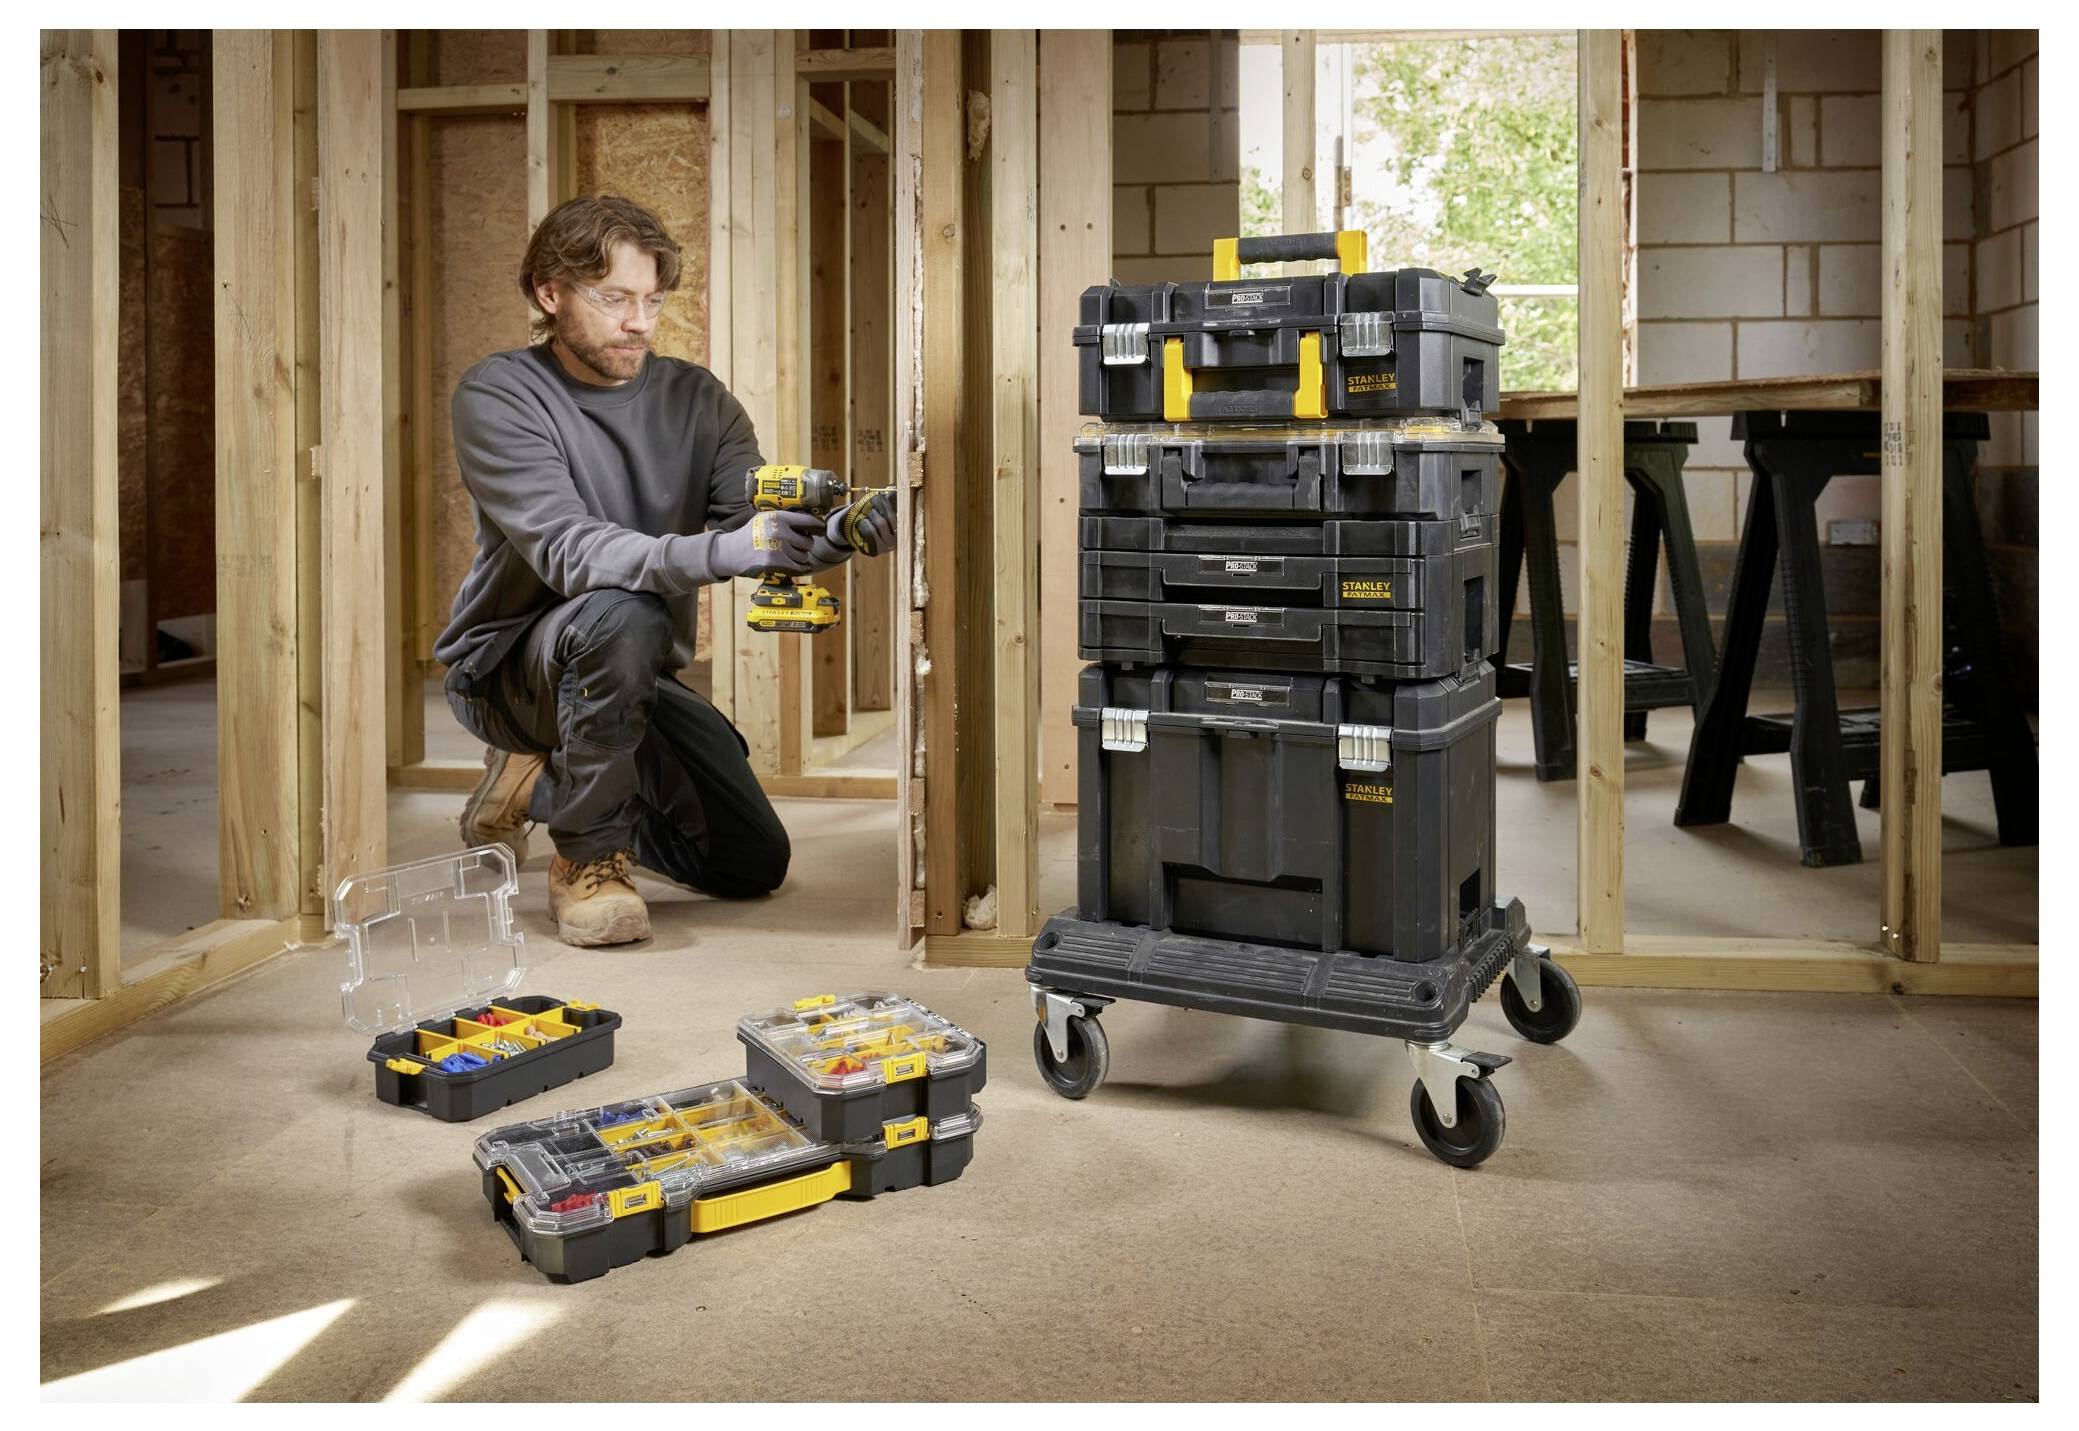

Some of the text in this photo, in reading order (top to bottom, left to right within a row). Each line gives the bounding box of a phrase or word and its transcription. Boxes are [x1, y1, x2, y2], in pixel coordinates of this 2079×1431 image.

[1348, 373, 1395, 385] STANLEY
[1342, 582, 1390, 591] STANLEY
[1345, 783, 1393, 796] STANLEY
